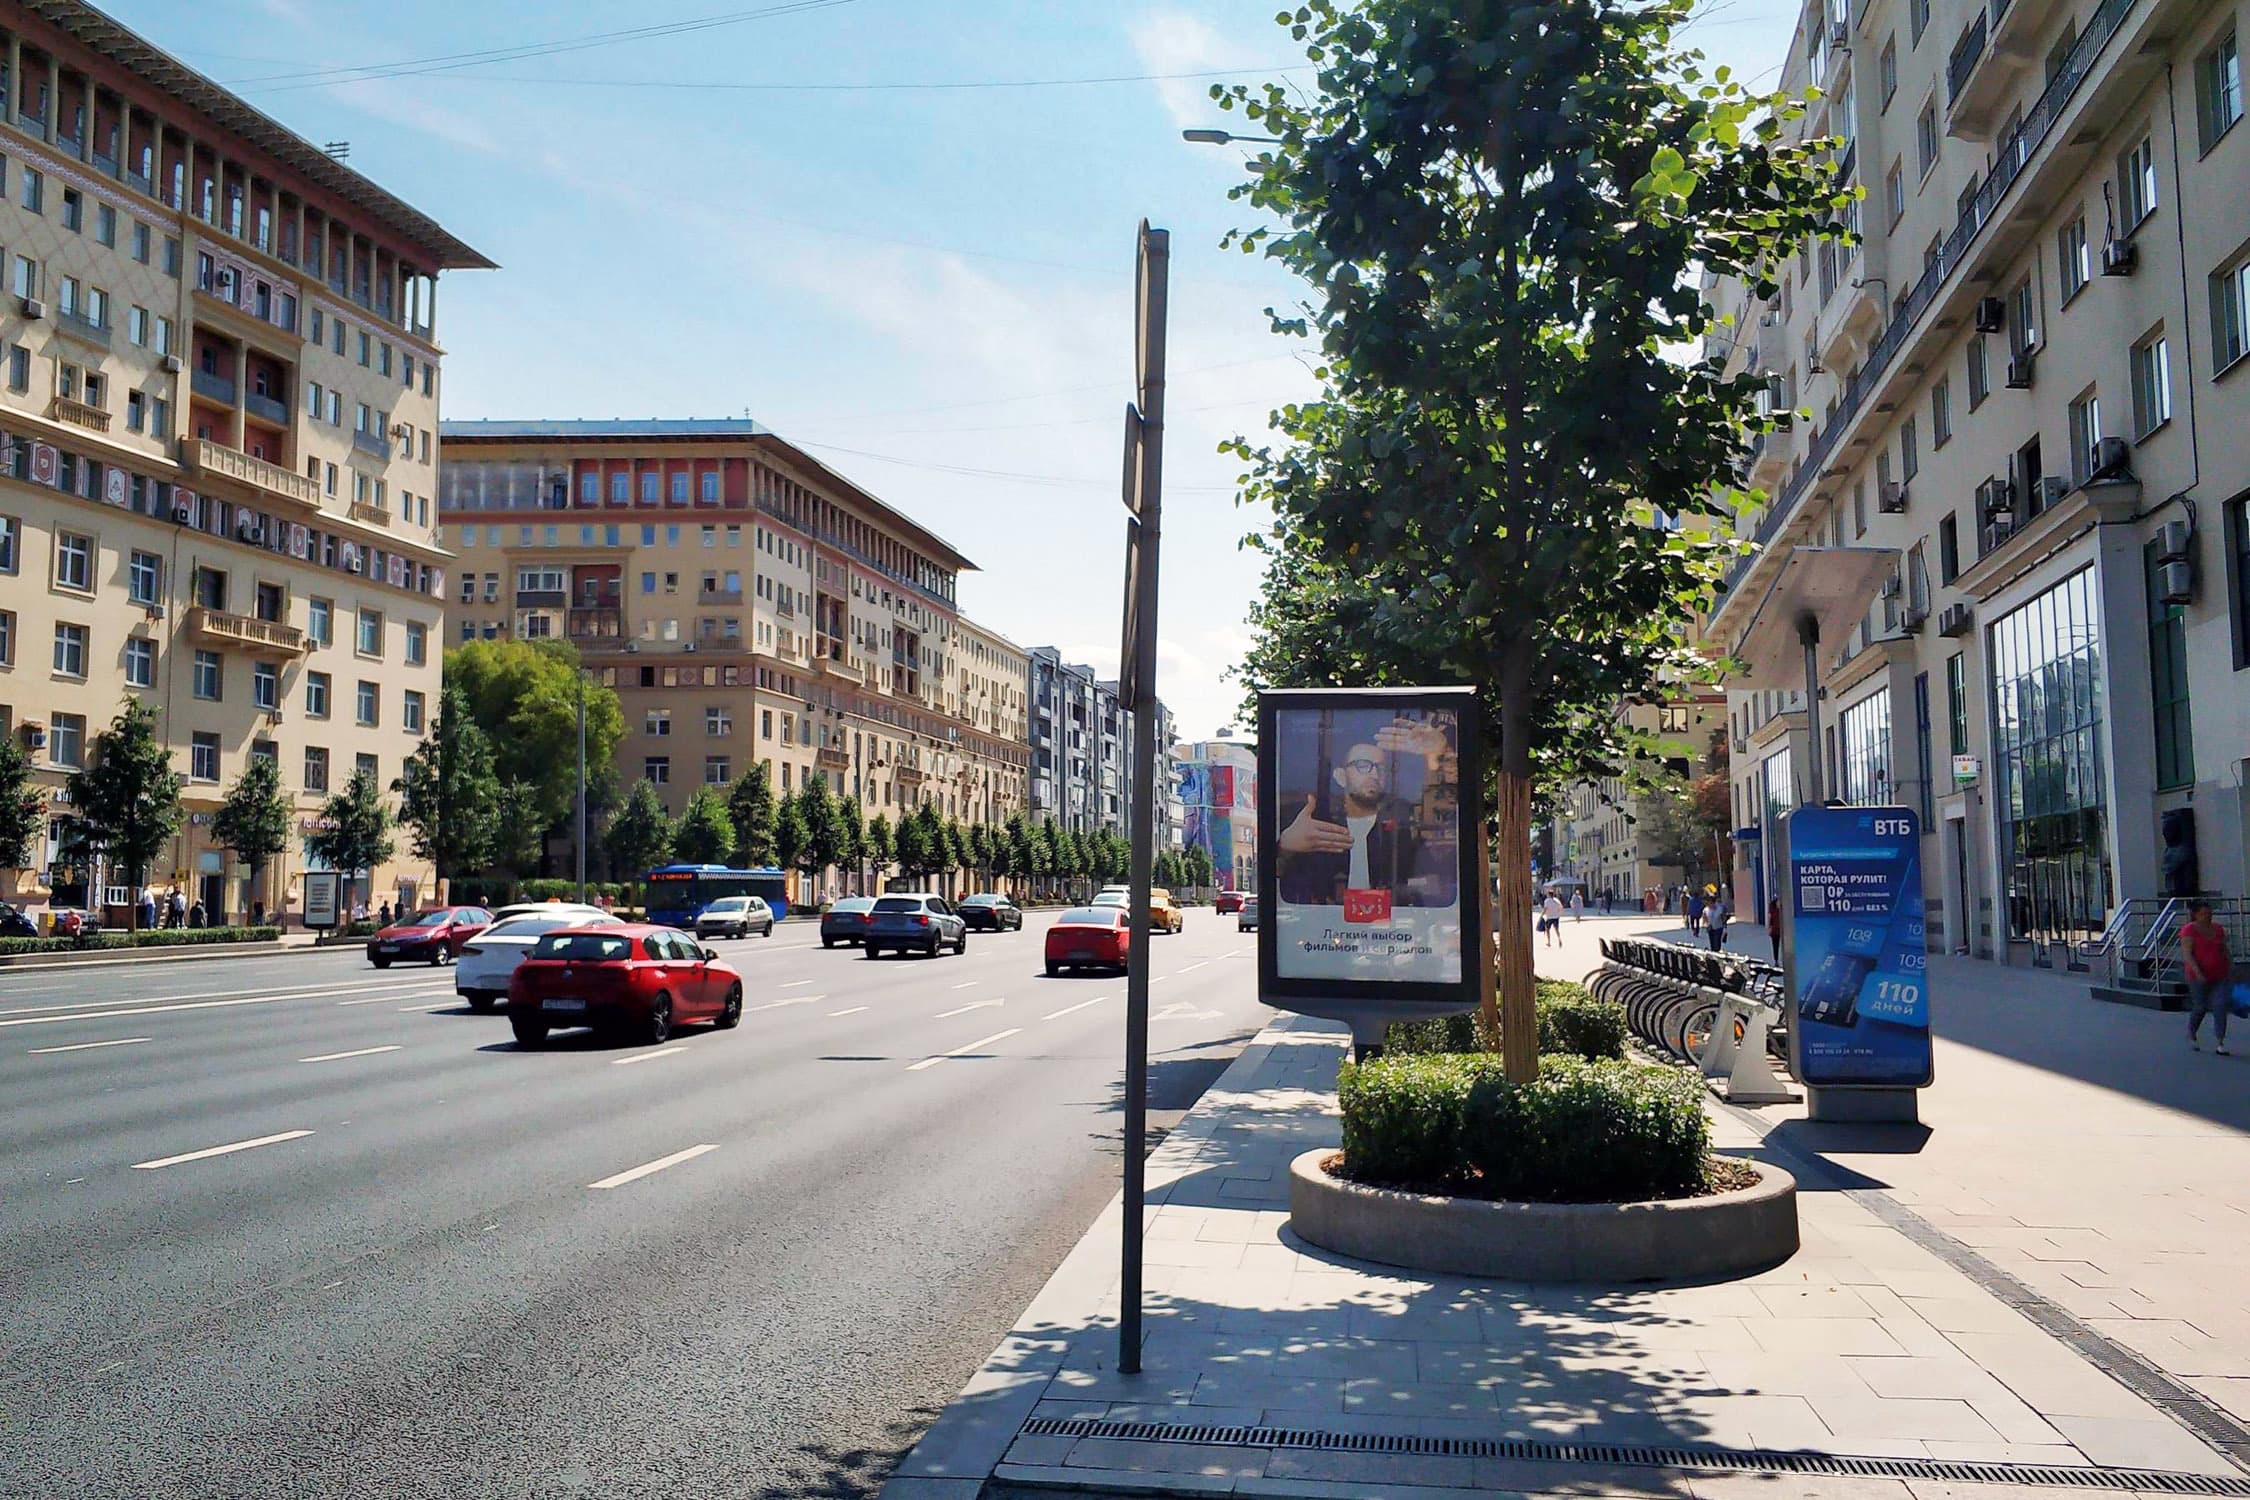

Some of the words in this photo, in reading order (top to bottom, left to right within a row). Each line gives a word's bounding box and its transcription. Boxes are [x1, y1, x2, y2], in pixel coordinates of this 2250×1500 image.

[1875, 820, 1910, 835] ВТБ
[1800, 866, 1837, 876] КАРТА,
[1800, 875, 1848, 885] КОТОРАЯ
[1850, 874, 1888, 884] РУЛИТ!
[1351, 898, 1384, 915] ivi
[1828, 899, 1851, 912] 110
[1372, 929, 1413, 943] выбор
[1847, 927, 1873, 942] 108
[1303, 942, 1359, 954] фильмов
[1878, 981, 1919, 1004] 110
[1871, 1001, 1914, 1015] дней
